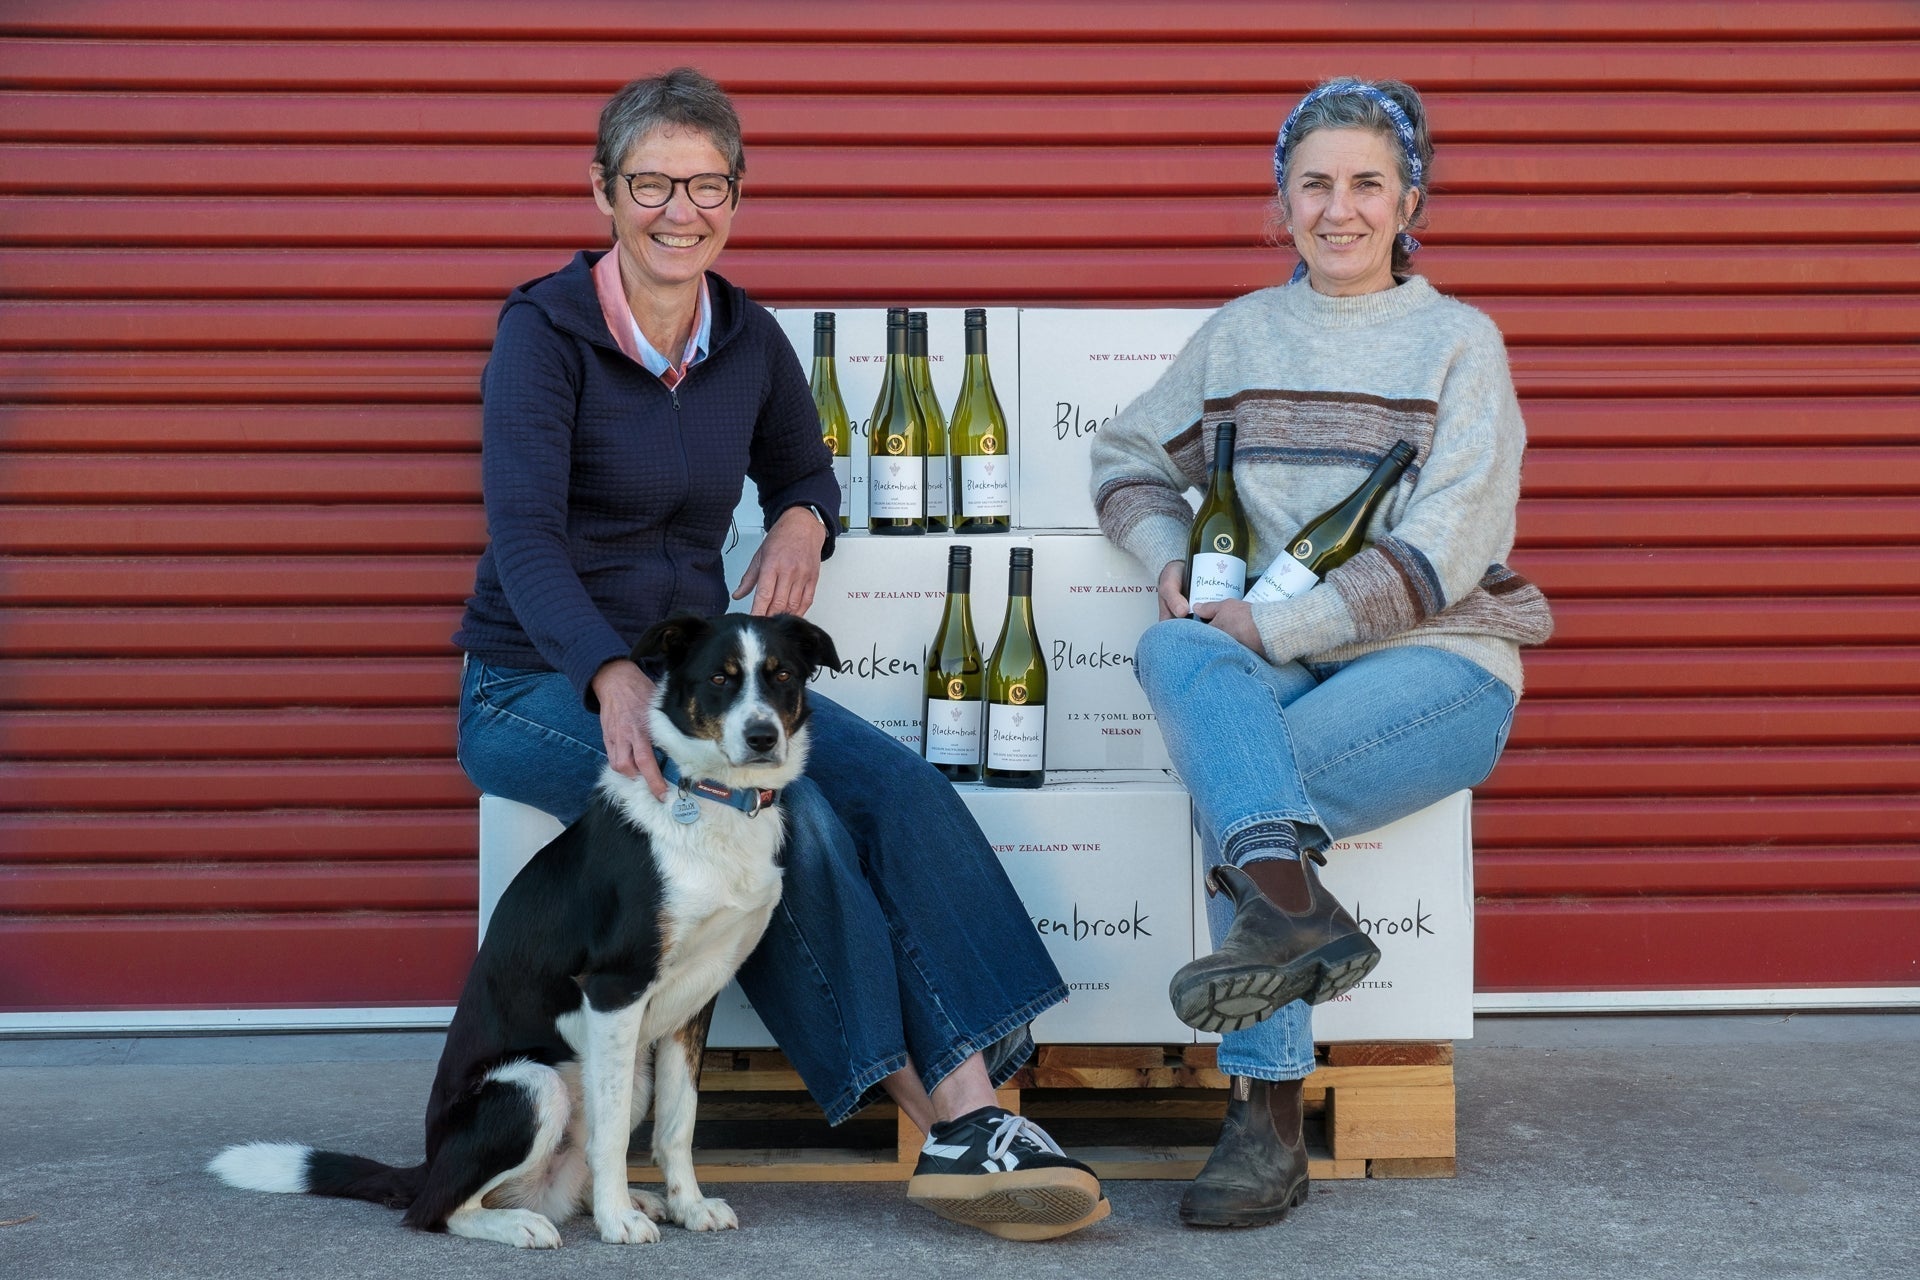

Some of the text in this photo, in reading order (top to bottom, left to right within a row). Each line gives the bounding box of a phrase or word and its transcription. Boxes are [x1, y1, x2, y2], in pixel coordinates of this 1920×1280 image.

[849, 355, 871, 363] NEW
[928, 354, 946, 363] INE
[1090, 353, 1179, 361] NEW ZEALAND WIN
[852, 475, 864, 484] 12
[873, 480, 918, 491] Blackenbrook
[967, 479, 1009, 491] Blackenbrook
[1196, 576, 1243, 592] Blackenbrook
[1070, 585, 1093, 594] NEW
[1096, 585, 1143, 594] ZEALAND
[848, 590, 946, 599] NEW ZEALAND WIN
[1051, 640, 1134, 671] Blacken
[1068, 713, 1080, 721] 12
[1084, 713, 1090, 721] X
[1094, 713, 1128, 721] 750ML
[932, 723, 977, 737] Blackenbrook
[1102, 727, 1142, 736] NELSON
[993, 729, 1040, 742] Blackenbrook
[1019, 844, 1068, 852] ZEALAND
[1072, 843, 1102, 852] WINE
[1353, 842, 1383, 850] WINE
[1068, 982, 1111, 991] OTTLES
[1352, 981, 1393, 989] OTTLES
